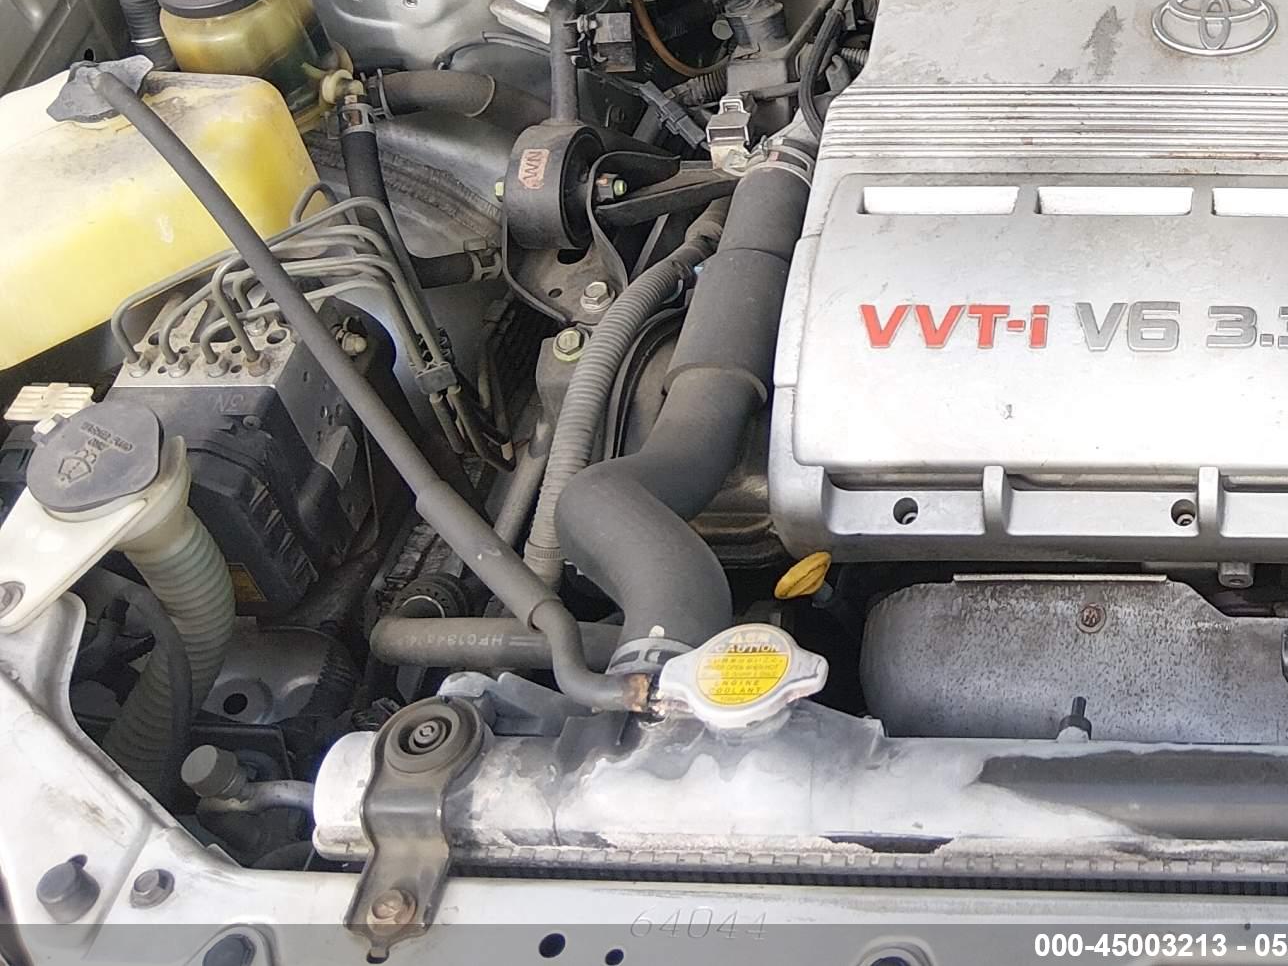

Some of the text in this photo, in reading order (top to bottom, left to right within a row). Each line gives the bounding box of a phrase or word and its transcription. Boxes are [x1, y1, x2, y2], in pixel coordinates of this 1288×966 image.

[859, 303, 1050, 349] VVT-i
[1075, 301, 1182, 352] V6
[629, 905, 769, 941] 64044
